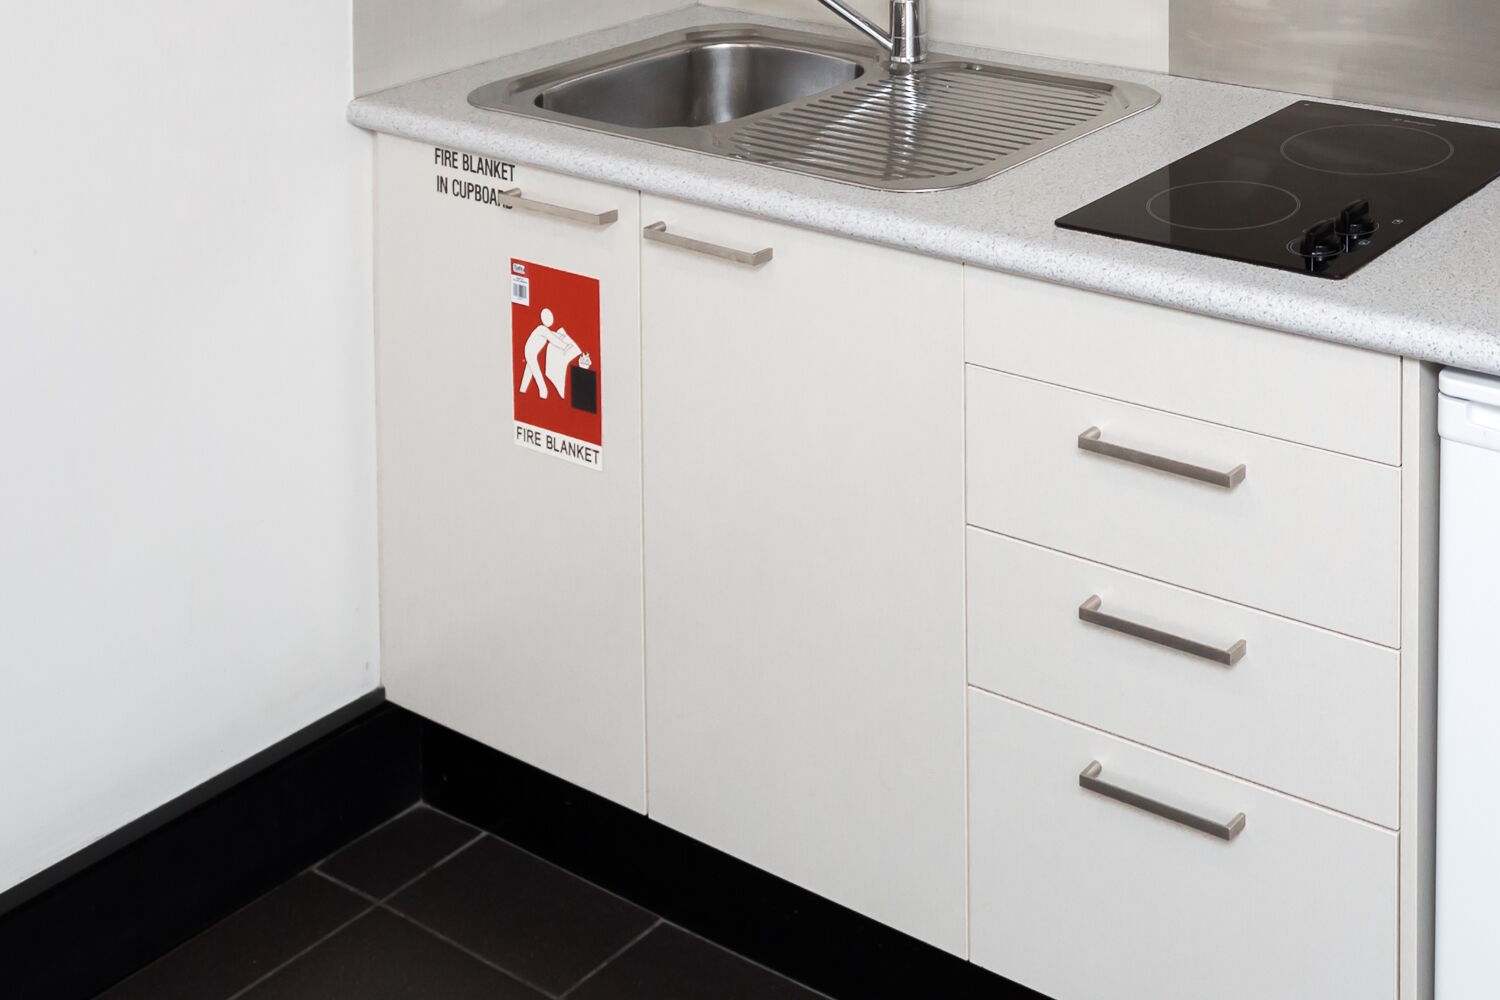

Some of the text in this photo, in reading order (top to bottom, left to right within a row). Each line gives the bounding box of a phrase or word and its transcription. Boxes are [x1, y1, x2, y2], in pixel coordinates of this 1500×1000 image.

[435, 147, 515, 182] FIRE BLANKET
[436, 175, 448, 194] IN
[516, 426, 600, 464] FIRE BLANKET
